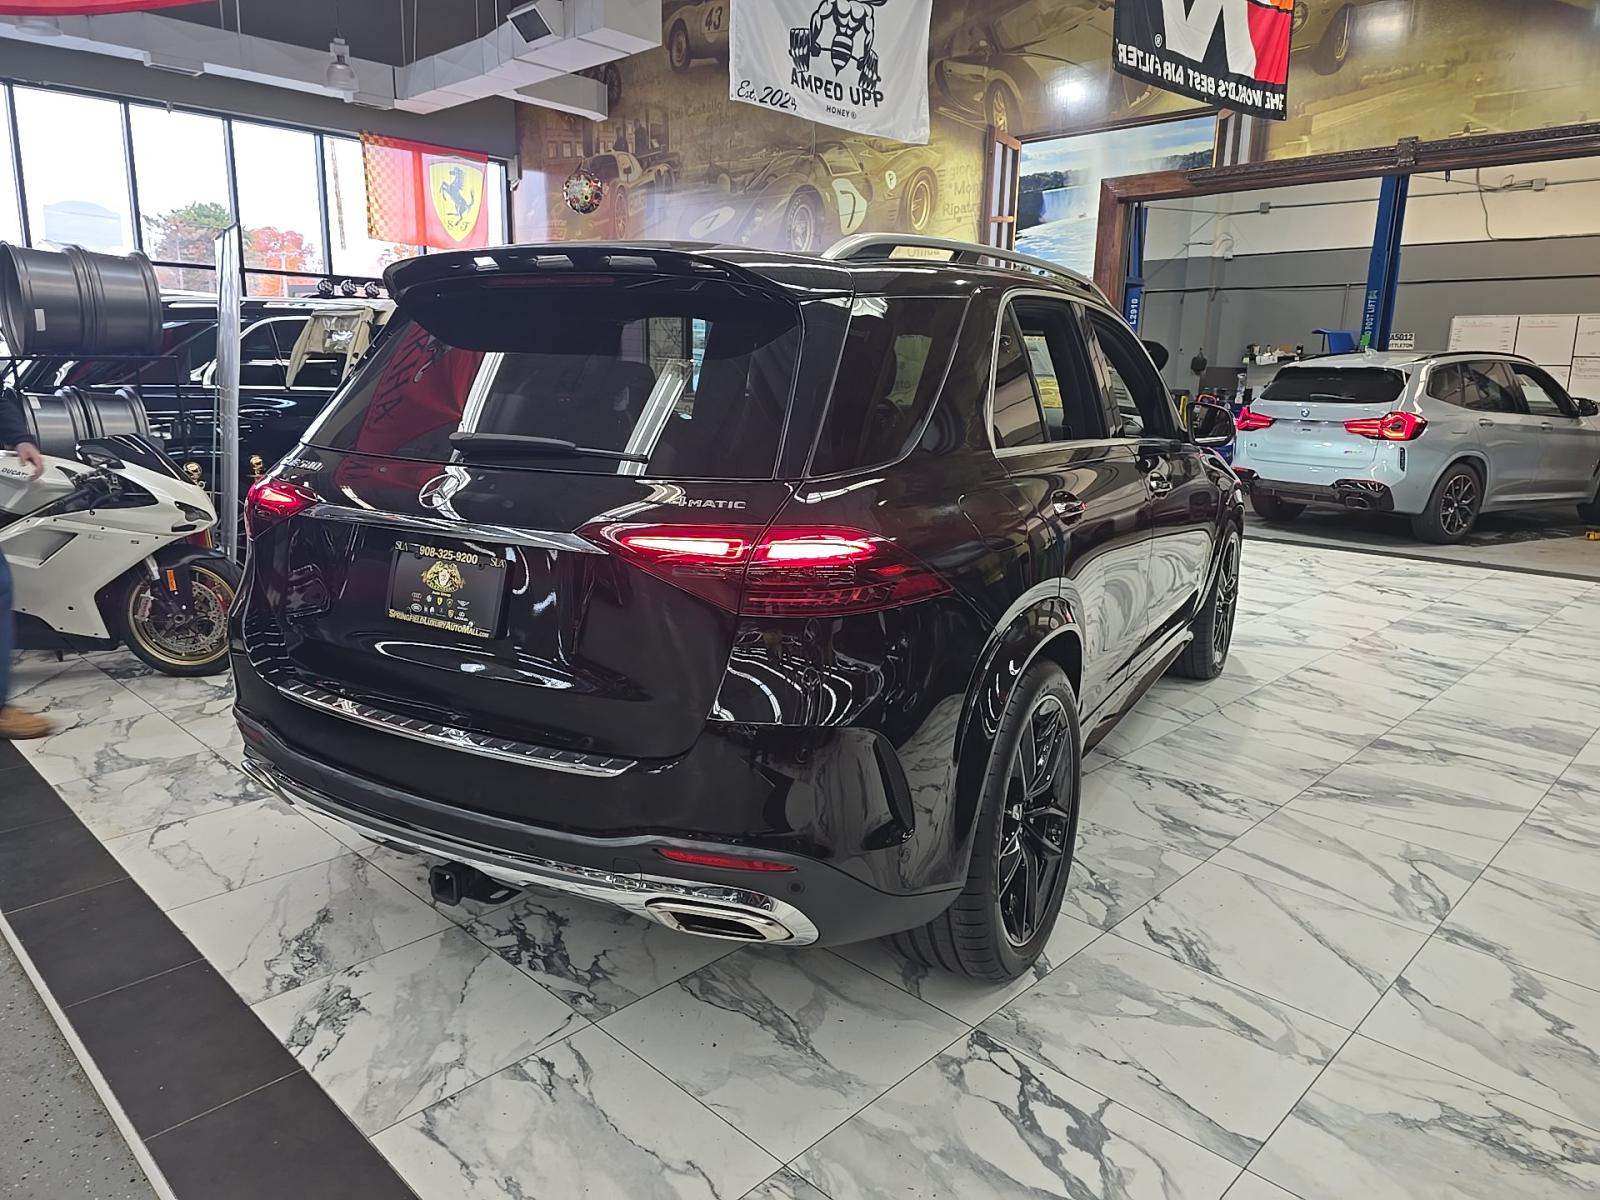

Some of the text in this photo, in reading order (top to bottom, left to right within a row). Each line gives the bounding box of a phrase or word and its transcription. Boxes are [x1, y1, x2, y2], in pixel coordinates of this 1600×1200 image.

[705, 6, 722, 31] 43
[737, 80, 797, 111] Est. 2024
[791, 67, 884, 107] AMPED UPP
[1130, 298, 1138, 325] L2910
[1365, 314, 1374, 331] POST
[1, 467, 29, 477] DUCAT
[677, 496, 747, 509] 4MATIC
[419, 545, 478, 564] 908-325-9200
